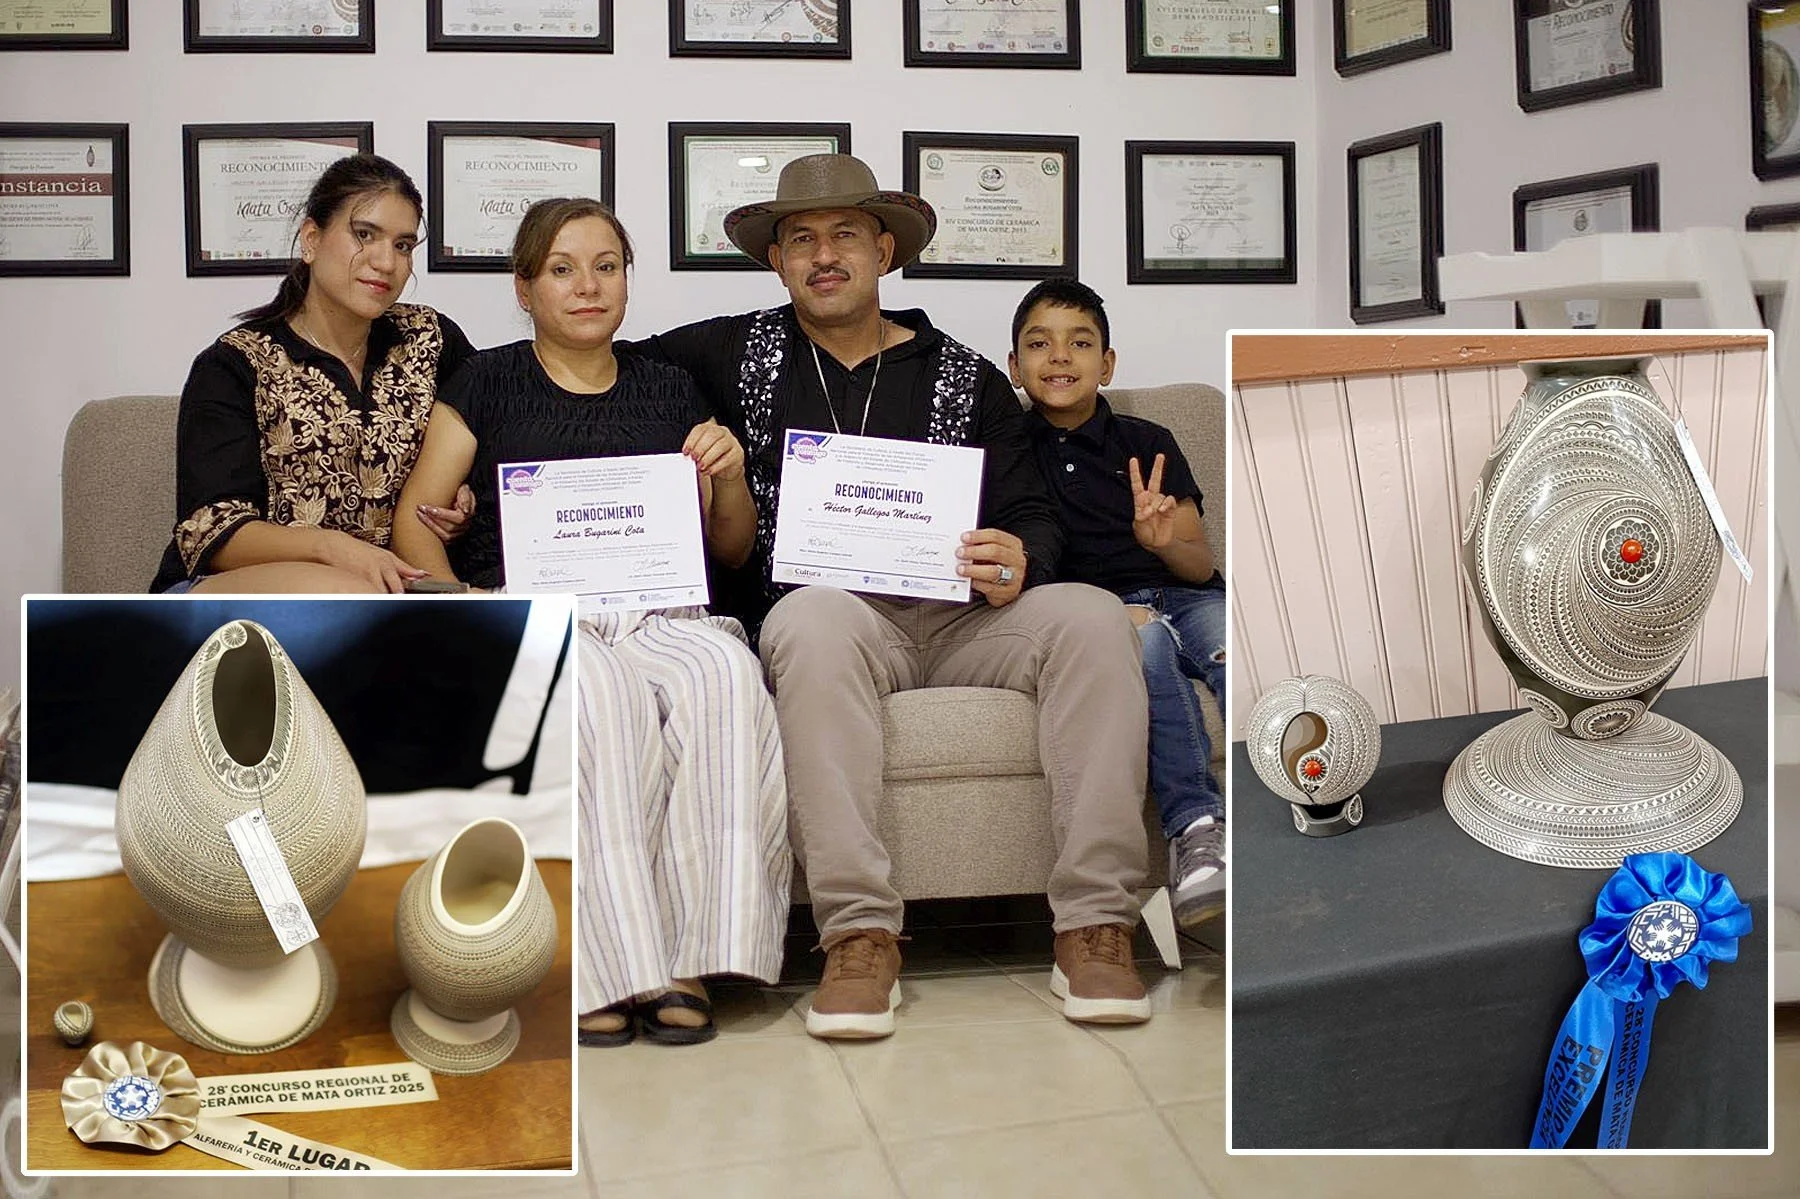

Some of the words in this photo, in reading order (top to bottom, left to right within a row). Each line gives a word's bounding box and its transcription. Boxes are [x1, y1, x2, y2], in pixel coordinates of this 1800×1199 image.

[465, 160, 578, 172] RECONOCIMIENTO
[835, 483, 924, 504] RECONOCIMIENTO
[556, 504, 645, 523] RECONOCIMIENTO
[823, 502, 852, 513] Héctor
[854, 505, 890, 518] Gallegos
[892, 508, 932, 523] Martínez
[553, 529, 581, 539] Laura
[584, 526, 621, 539] Bugarini
[624, 524, 645, 537] Cota
[794, 568, 822, 578] Cultura
[1624, 1031, 1641, 1107] CONCURSO
[231, 1080, 311, 1094] CONCURSO
[316, 1075, 388, 1089] REGIONAL
[392, 1072, 411, 1083] DE
[279, 1092, 298, 1103] DE
[302, 1089, 341, 1101] MATA
[344, 1086, 386, 1098] ORTIZ
[390, 1082, 425, 1095] 2025
[1554, 1045, 1604, 1134] PREMIO
[1614, 1080, 1624, 1100] DE
[1609, 1102, 1622, 1139] MATA
[193, 1133, 243, 1155] ALFARERÍA
[246, 1149, 252, 1157] Y
[243, 1130, 283, 1156] 1ER
